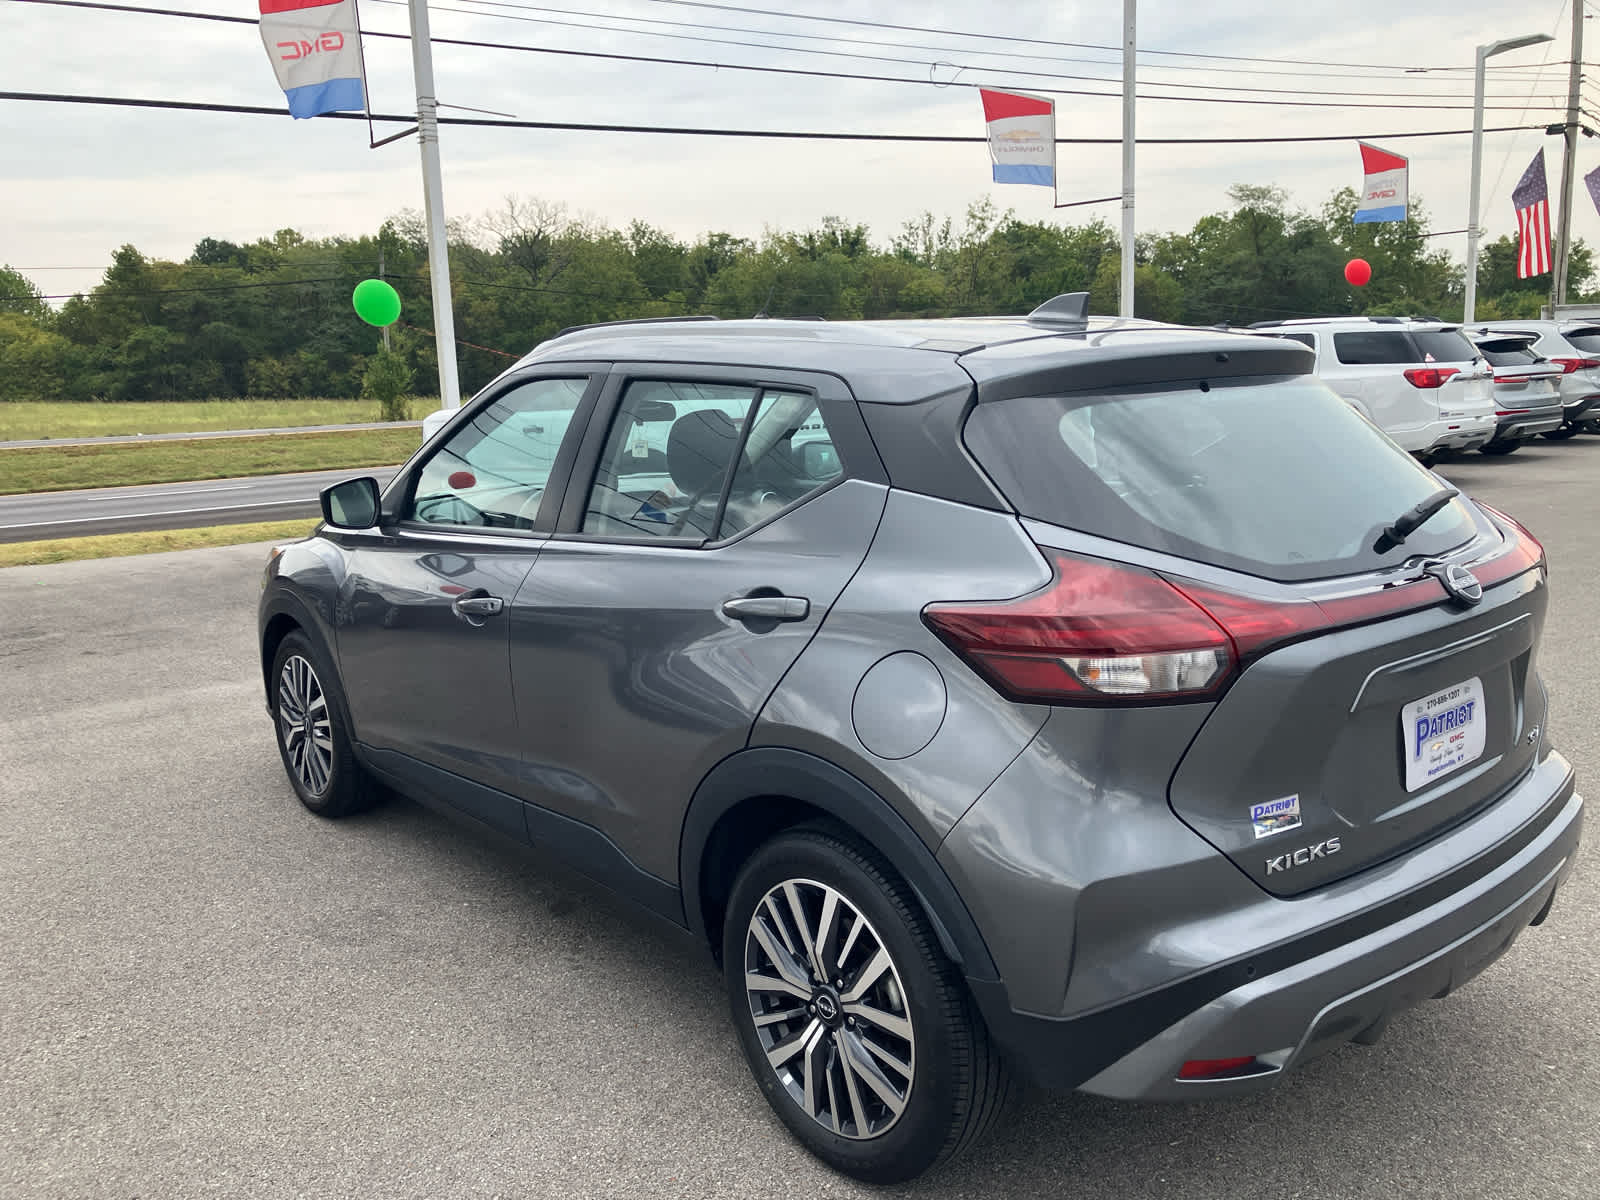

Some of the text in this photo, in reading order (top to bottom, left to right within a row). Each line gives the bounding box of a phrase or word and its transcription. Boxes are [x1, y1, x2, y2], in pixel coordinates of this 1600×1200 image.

[1415, 701, 1475, 757] PATRIOT
[1449, 732, 1465, 743] GMC
[1253, 797, 1297, 824] PATRIOT
[1265, 836, 1341, 876] KICKS
